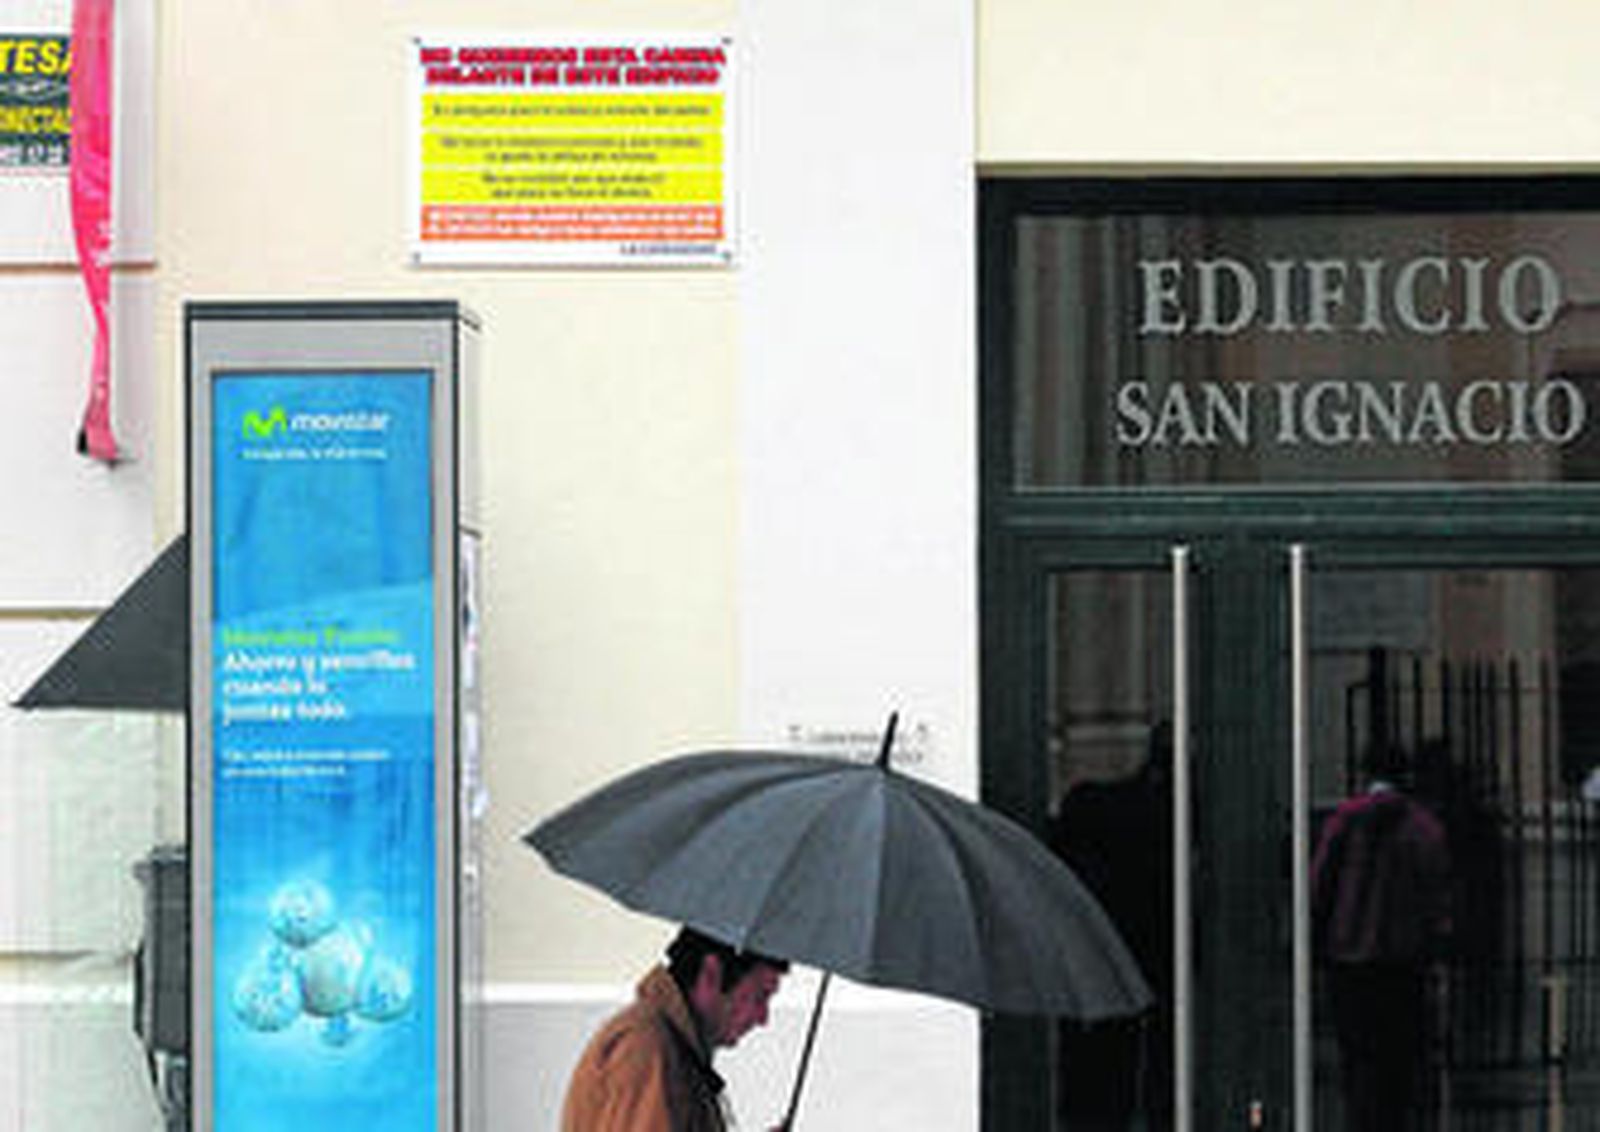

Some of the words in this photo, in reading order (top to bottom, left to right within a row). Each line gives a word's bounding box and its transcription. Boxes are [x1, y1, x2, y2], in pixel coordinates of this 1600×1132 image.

[1139, 256, 1562, 335] EDIFICIO
[1116, 380, 1253, 446] SAN
[1277, 378, 1586, 446] IGNACIO
